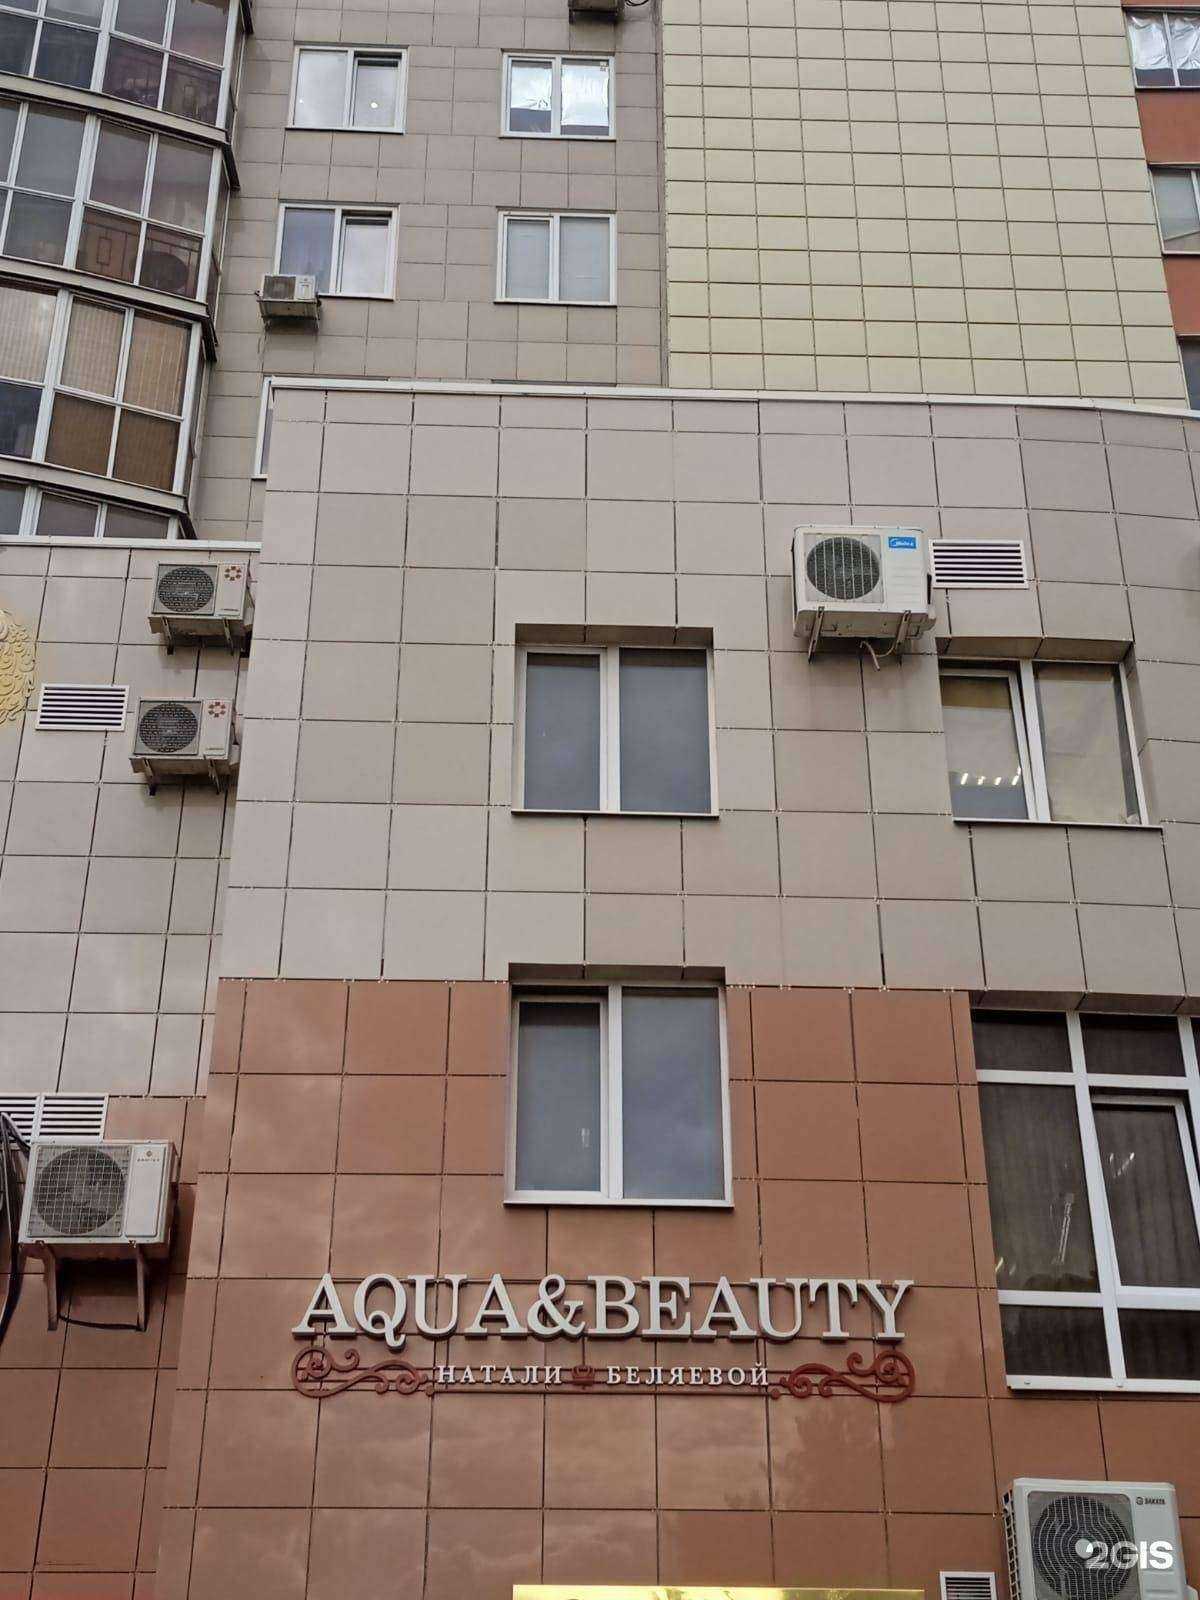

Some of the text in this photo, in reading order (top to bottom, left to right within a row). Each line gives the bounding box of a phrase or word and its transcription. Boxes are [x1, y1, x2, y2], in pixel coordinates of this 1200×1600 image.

[292, 1272, 914, 1349] AQUA&BEAUTY
[437, 1362, 769, 1386] НАТАЛИ БЕЛЯЕВОЙ
